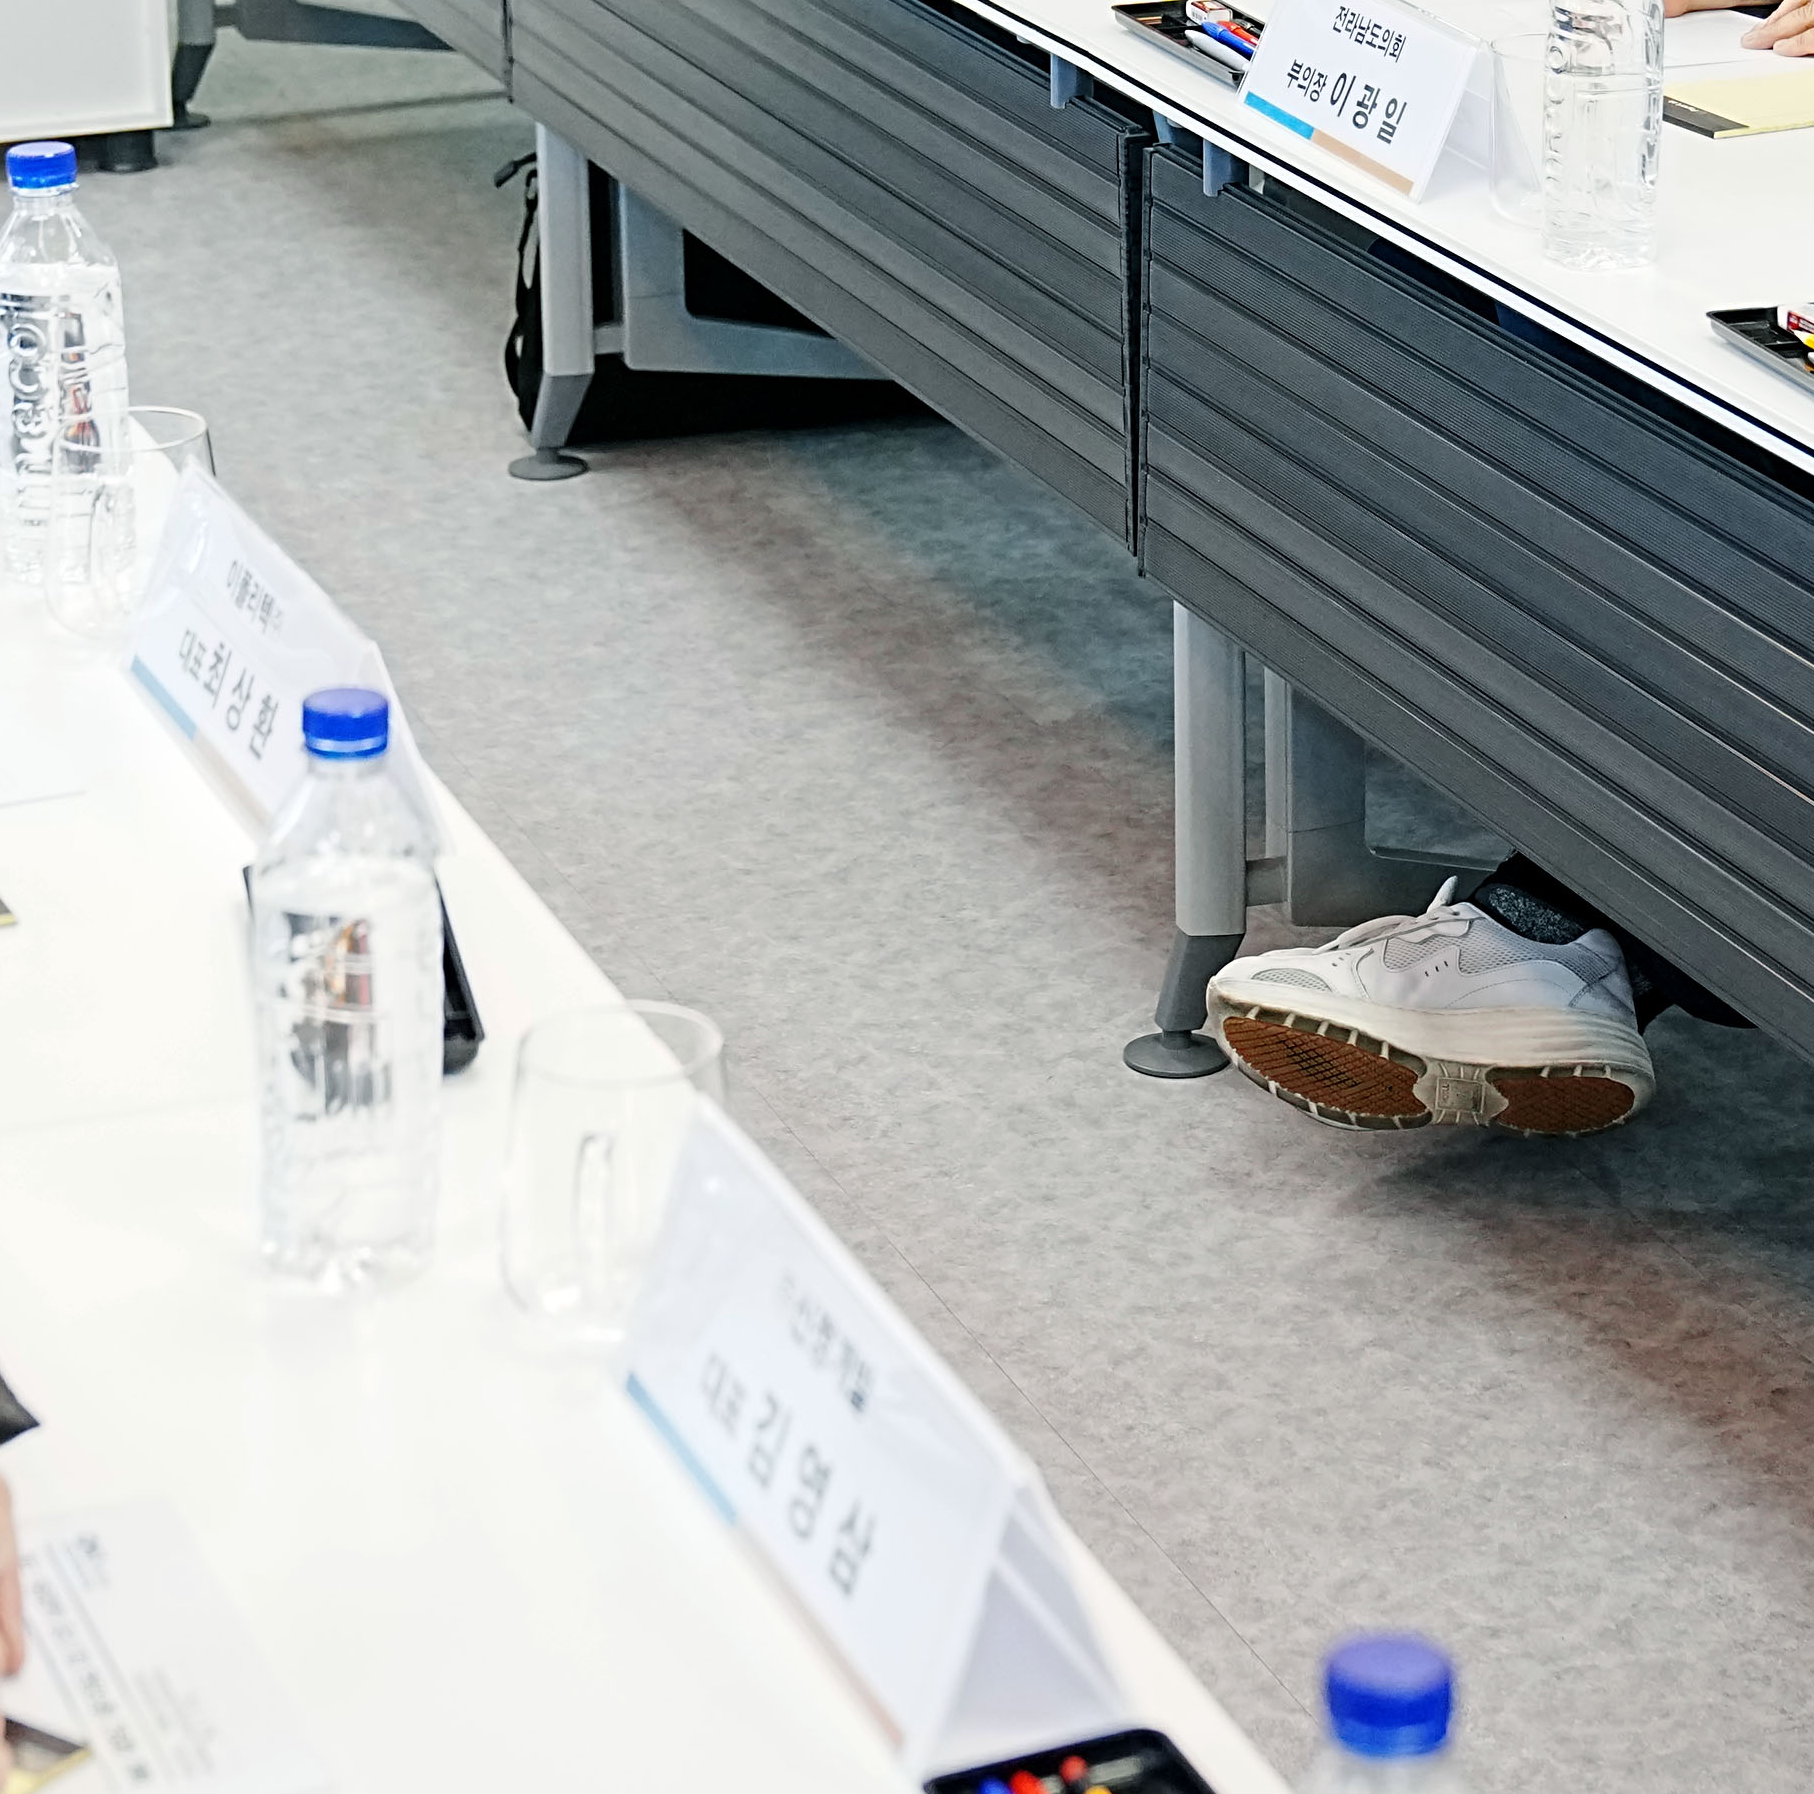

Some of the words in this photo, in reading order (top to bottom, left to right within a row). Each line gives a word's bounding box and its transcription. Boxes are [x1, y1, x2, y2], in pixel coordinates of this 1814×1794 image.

[1331, 3, 1407, 63] 전라남도의회
[1286, 57, 1328, 105] 부의장
[1330, 70, 1409, 145] 이광일
[177, 628, 208, 685] 대표
